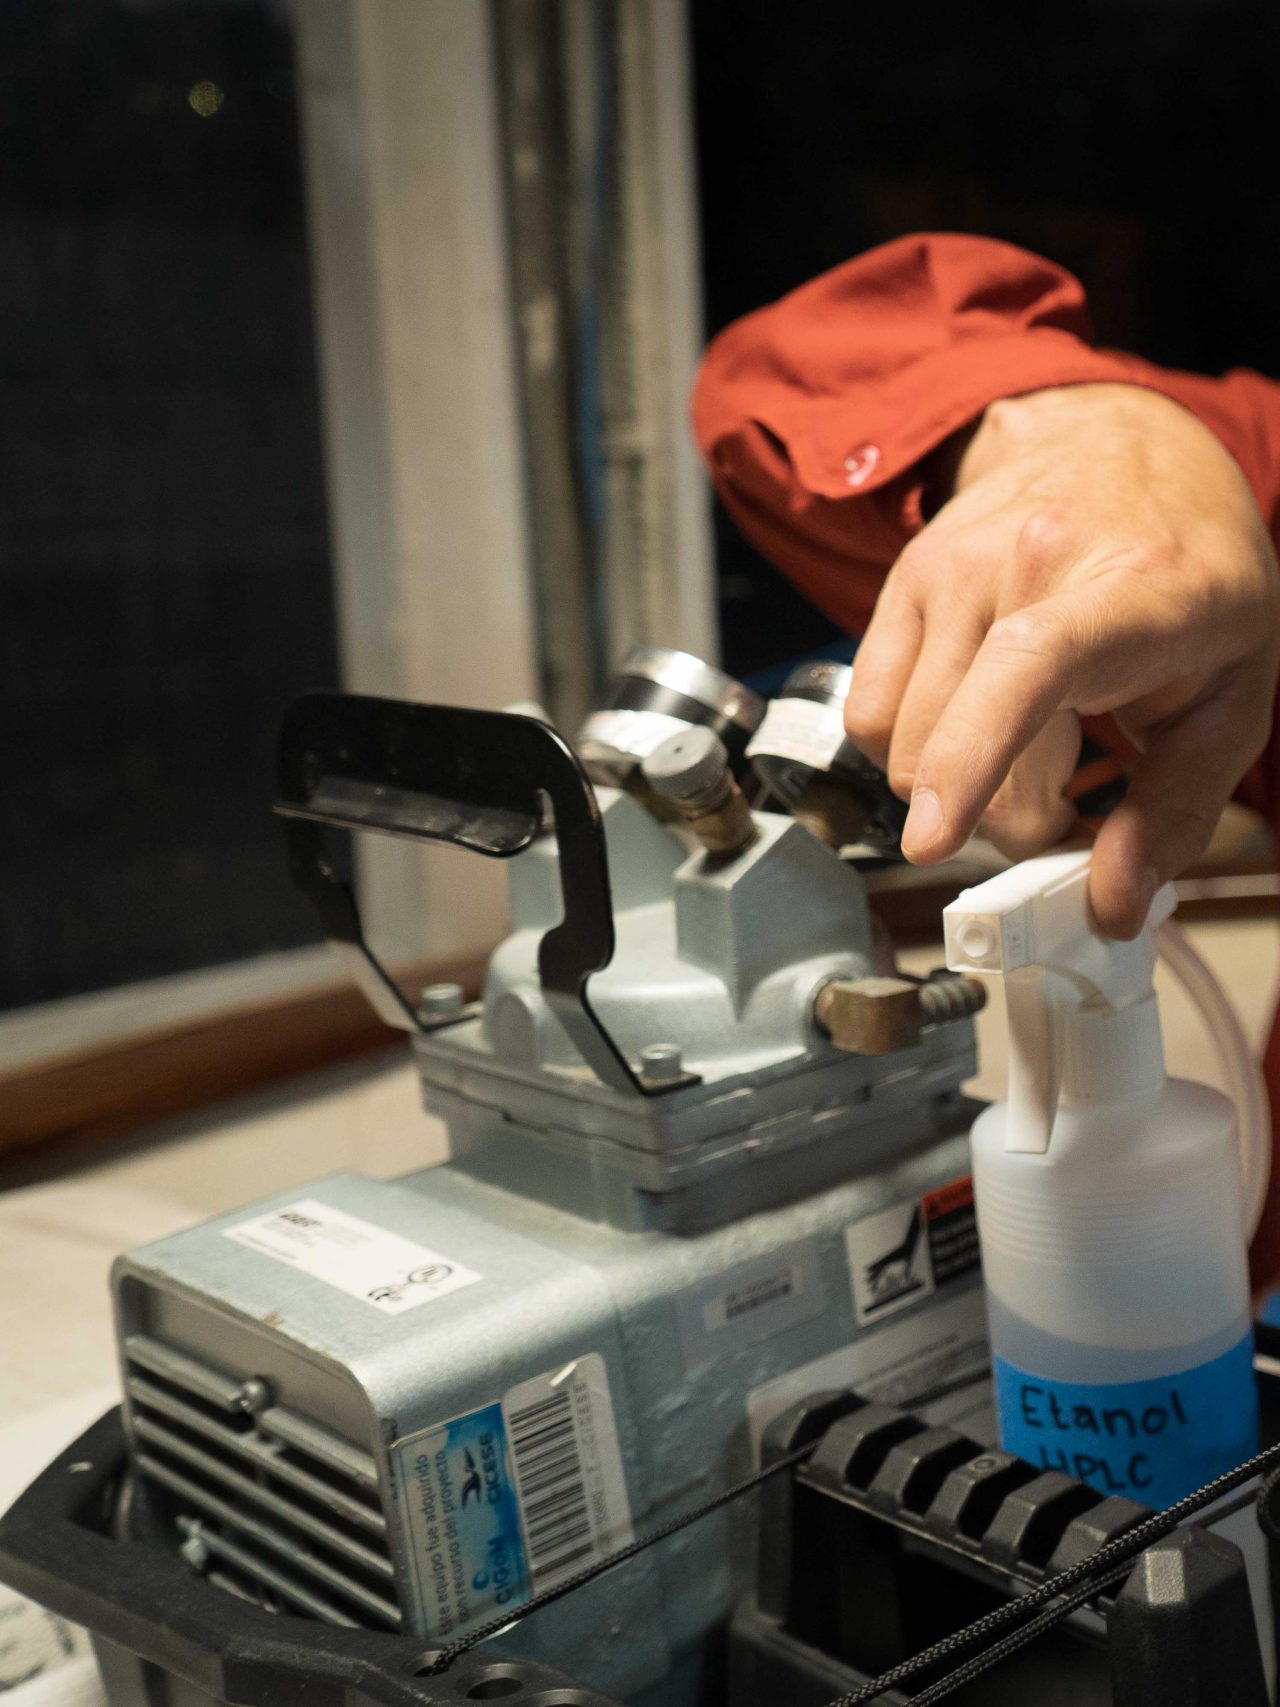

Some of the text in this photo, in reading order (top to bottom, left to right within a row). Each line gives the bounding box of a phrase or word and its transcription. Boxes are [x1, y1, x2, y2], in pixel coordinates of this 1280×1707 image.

[1021, 1384, 1188, 1438] Etanol
[413, 1454, 437, 1523] adquirido
[434, 1450, 457, 1513] proyecto
[479, 1432, 502, 1504] CICESE
[1040, 1445, 1153, 1490] HPLC
[424, 1526, 441, 1552] fue
[442, 1517, 458, 1540] del
[429, 1553, 451, 1603] equipo
[448, 1542, 467, 1595] recurso
